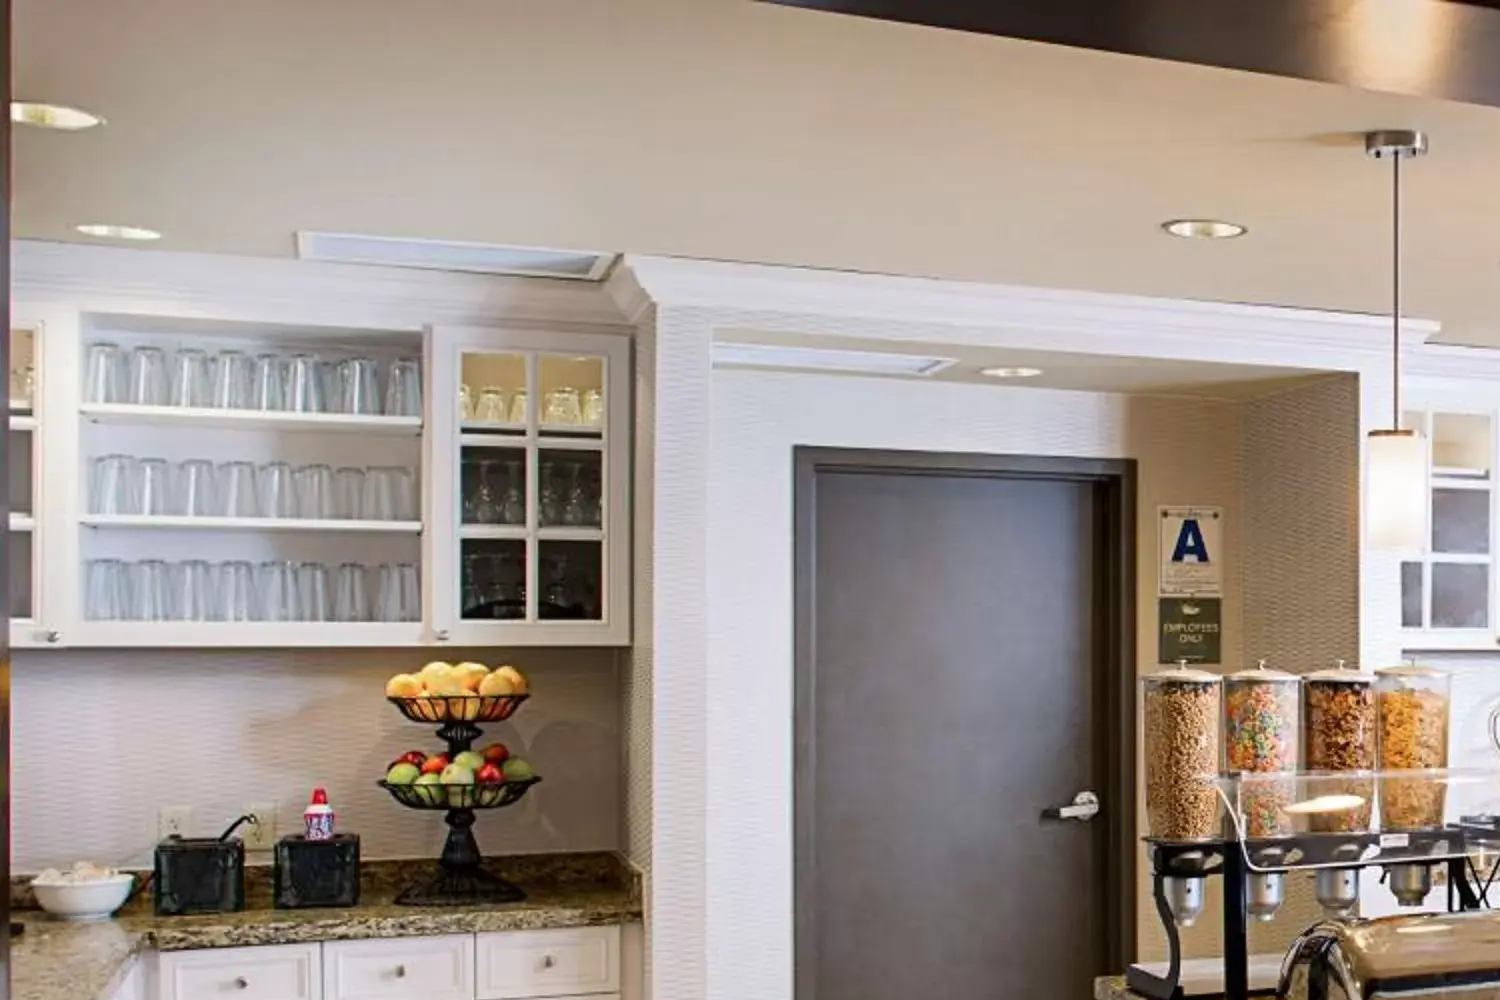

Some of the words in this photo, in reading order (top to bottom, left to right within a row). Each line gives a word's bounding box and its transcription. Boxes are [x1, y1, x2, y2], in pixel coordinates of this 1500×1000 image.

[1171, 519, 1210, 562] A
[1163, 623, 1219, 633] EMPLOYEES
[1179, 633, 1203, 643] ONLY
